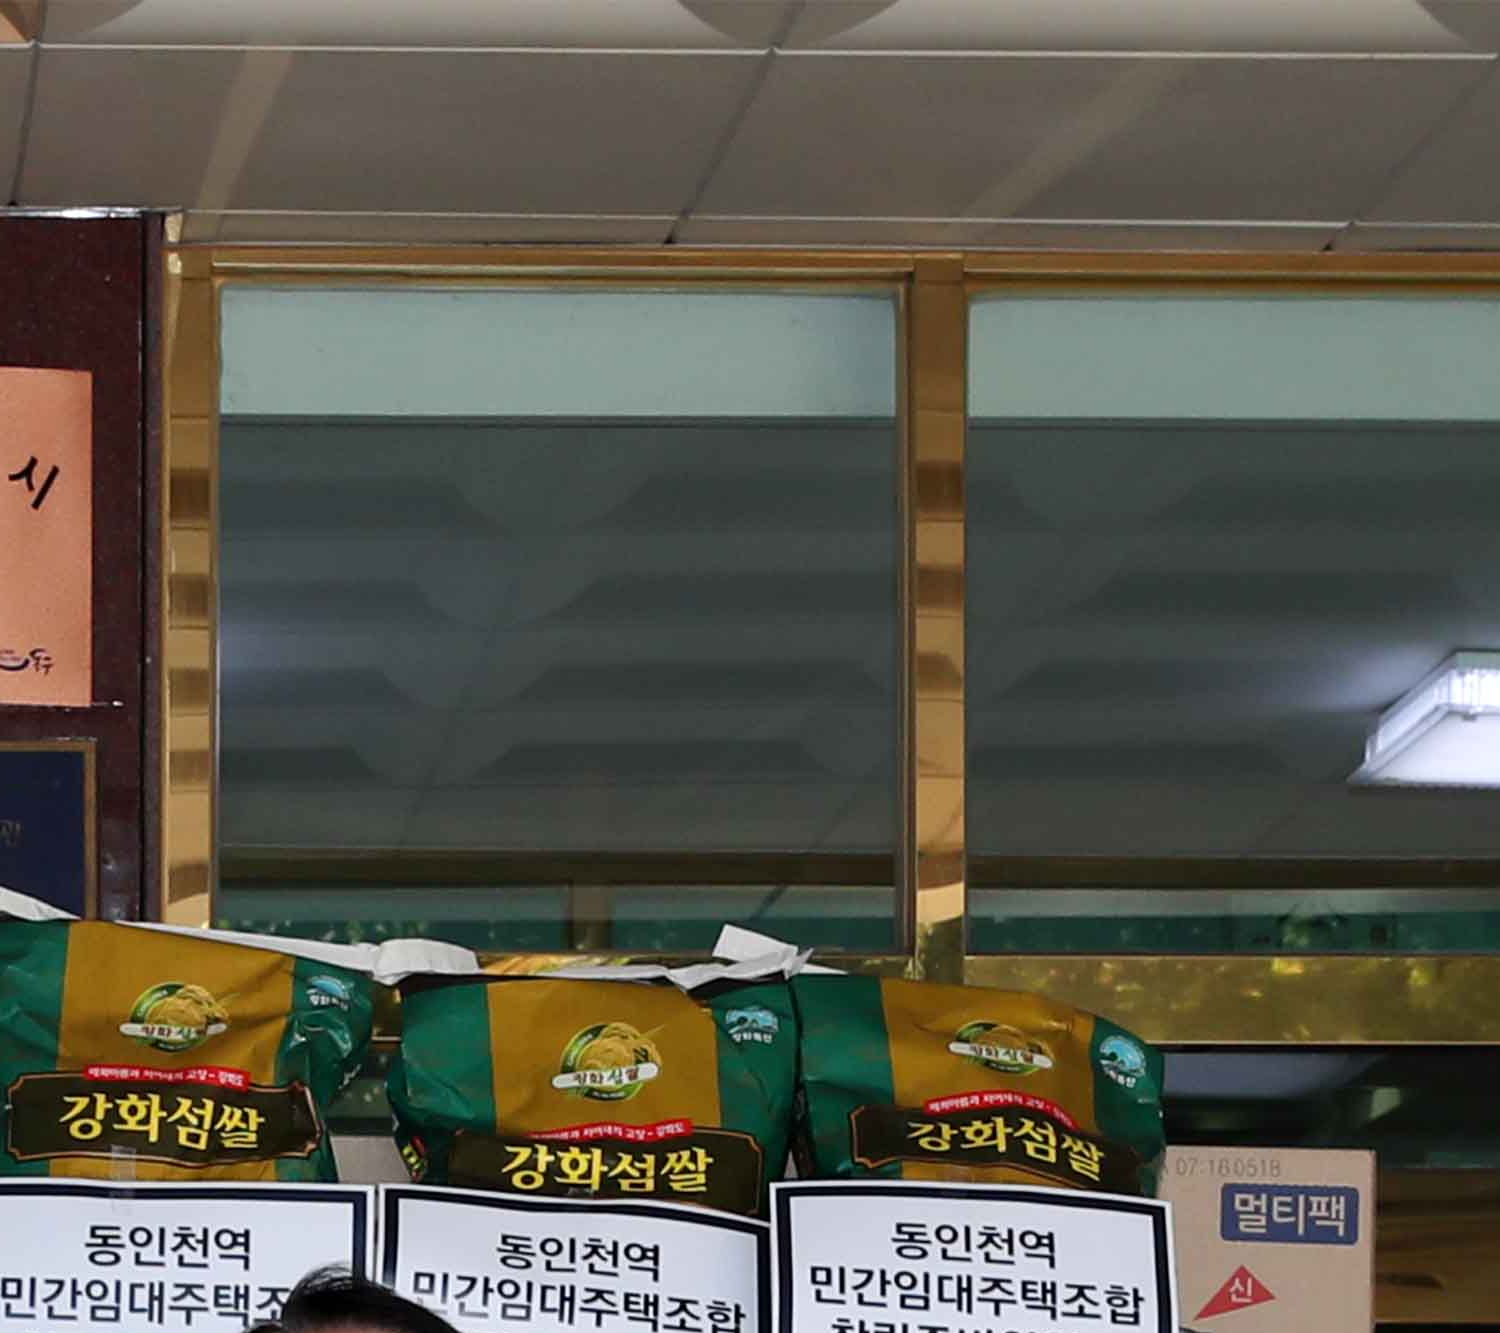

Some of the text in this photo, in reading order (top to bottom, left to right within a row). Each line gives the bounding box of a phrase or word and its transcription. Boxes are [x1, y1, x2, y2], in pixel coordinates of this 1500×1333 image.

[59, 1092, 264, 1149] 강화섬쌀
[501, 1144, 715, 1193] 강화섬쌀
[906, 1115, 1105, 1181] 강화섬쌀
[1234, 1192, 1346, 1236] 멀티팩
[84, 1226, 251, 1268] 동인천역
[496, 1232, 661, 1282] 동인천역
[891, 1221, 1057, 1268] 동인천역
[1, 1277, 291, 1326] 민간임대주택조
[810, 1265, 1144, 1326] 민간임대주택조합
